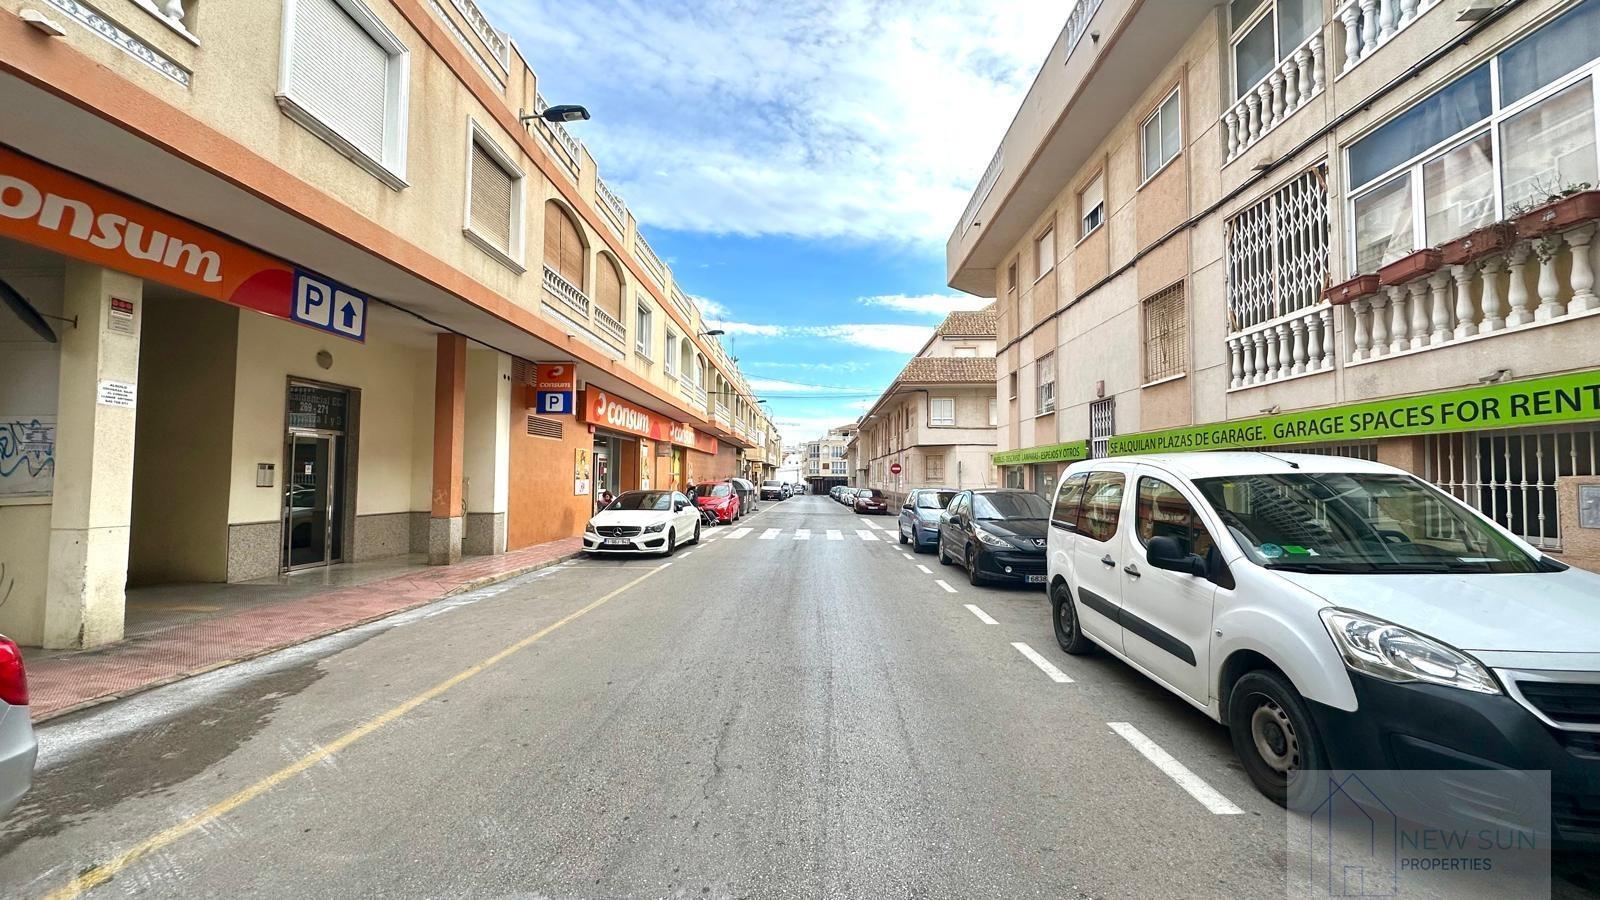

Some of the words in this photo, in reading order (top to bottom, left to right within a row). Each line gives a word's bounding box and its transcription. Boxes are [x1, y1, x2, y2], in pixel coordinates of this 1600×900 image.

[305, 283, 324, 316] P
[539, 381, 571, 389] consum
[550, 395, 560, 410] P
[607, 402, 650, 434] consum
[1110, 442, 1118, 454] SE
[1119, 438, 1157, 453] ALQUILAN
[1158, 434, 1193, 449] PLAZAS
[1195, 431, 1209, 446] DE
[1211, 425, 1267, 445] GARAGE.
[1273, 414, 1345, 440] GARAGE
[1349, 404, 1436, 432] SPACES
[1441, 397, 1500, 425] FOR
[1510, 384, 1600, 418] RENT
[1063, 446, 1080, 457] OTROS
